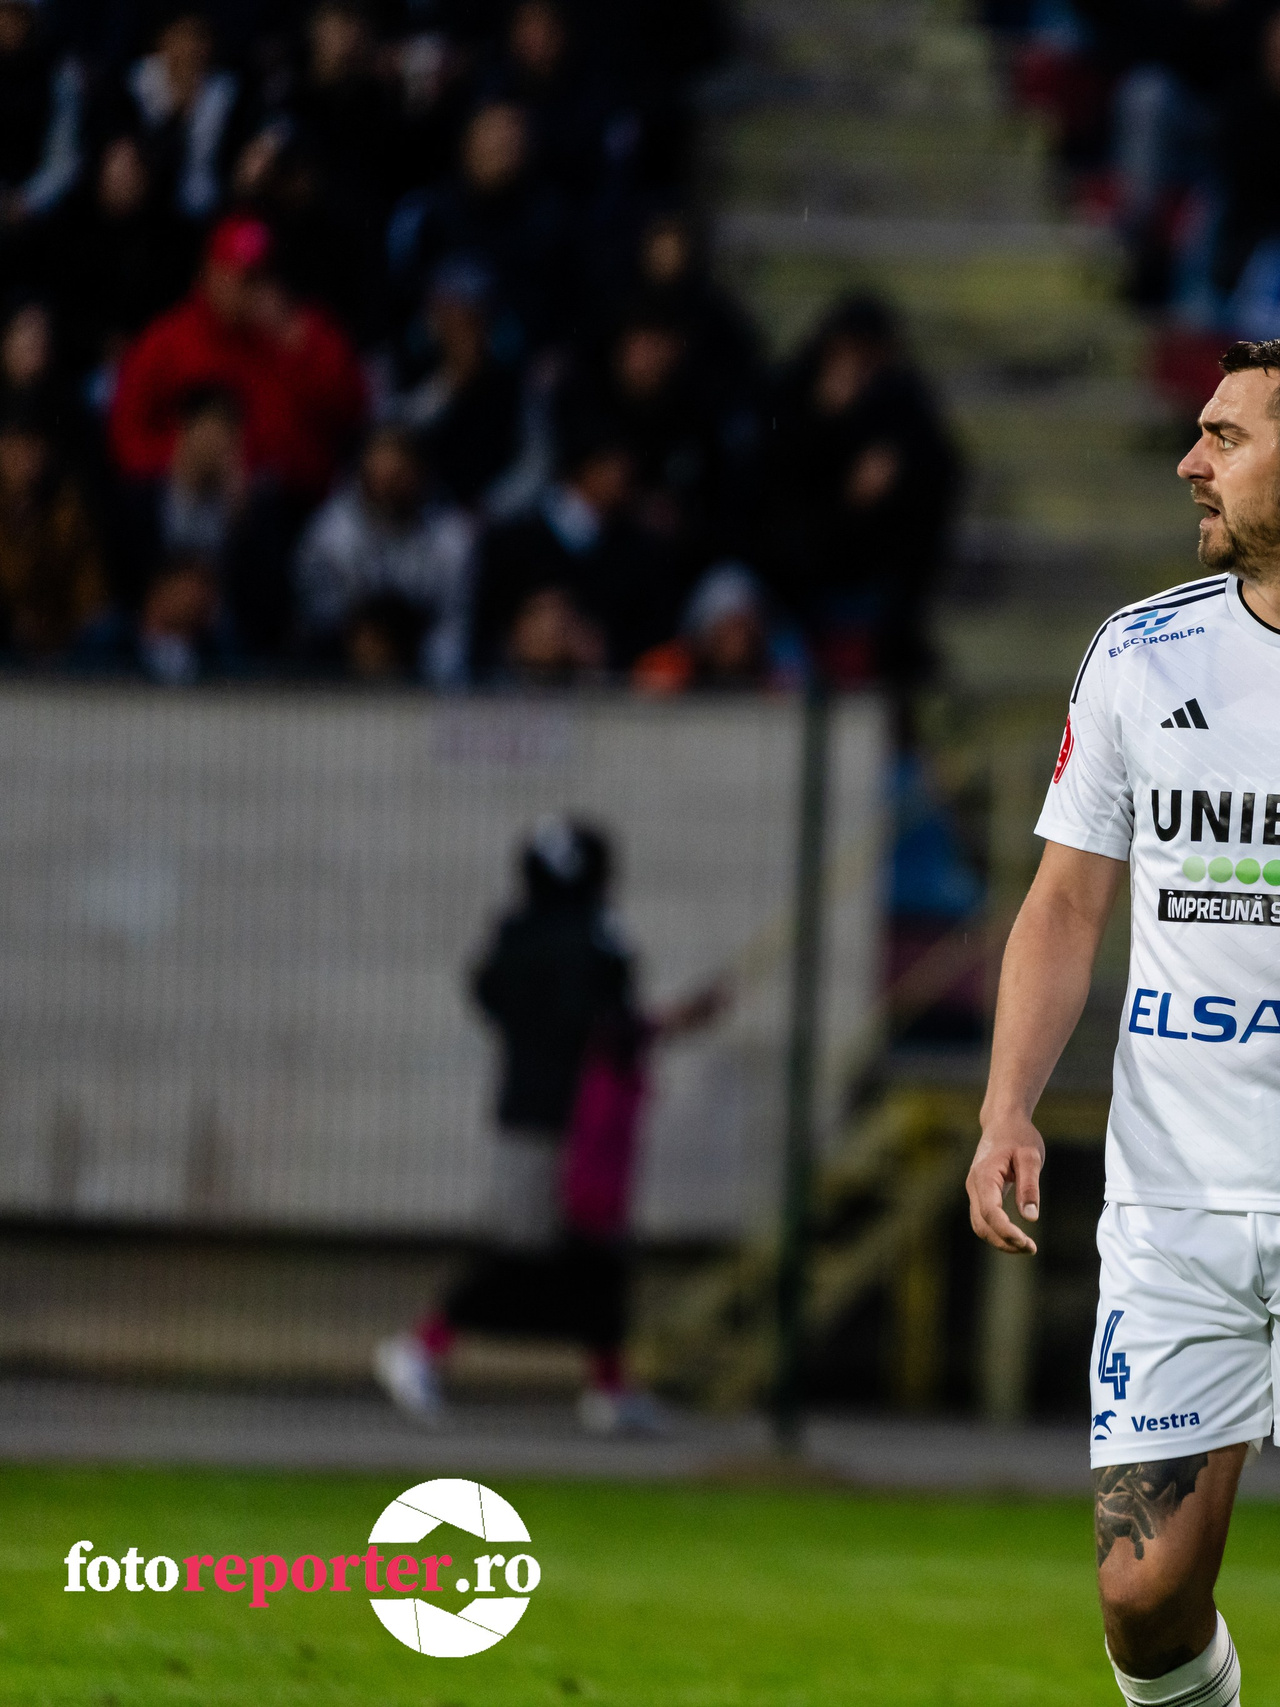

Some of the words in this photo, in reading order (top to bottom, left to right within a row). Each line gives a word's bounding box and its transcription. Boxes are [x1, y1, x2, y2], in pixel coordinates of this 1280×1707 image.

[1108, 626, 1205, 658] ELECTROALFA
[1167, 891, 1265, 922] ÎMPREUNĂ
[1098, 1309, 1131, 1401] 4
[1131, 1411, 1200, 1433] Vestra
